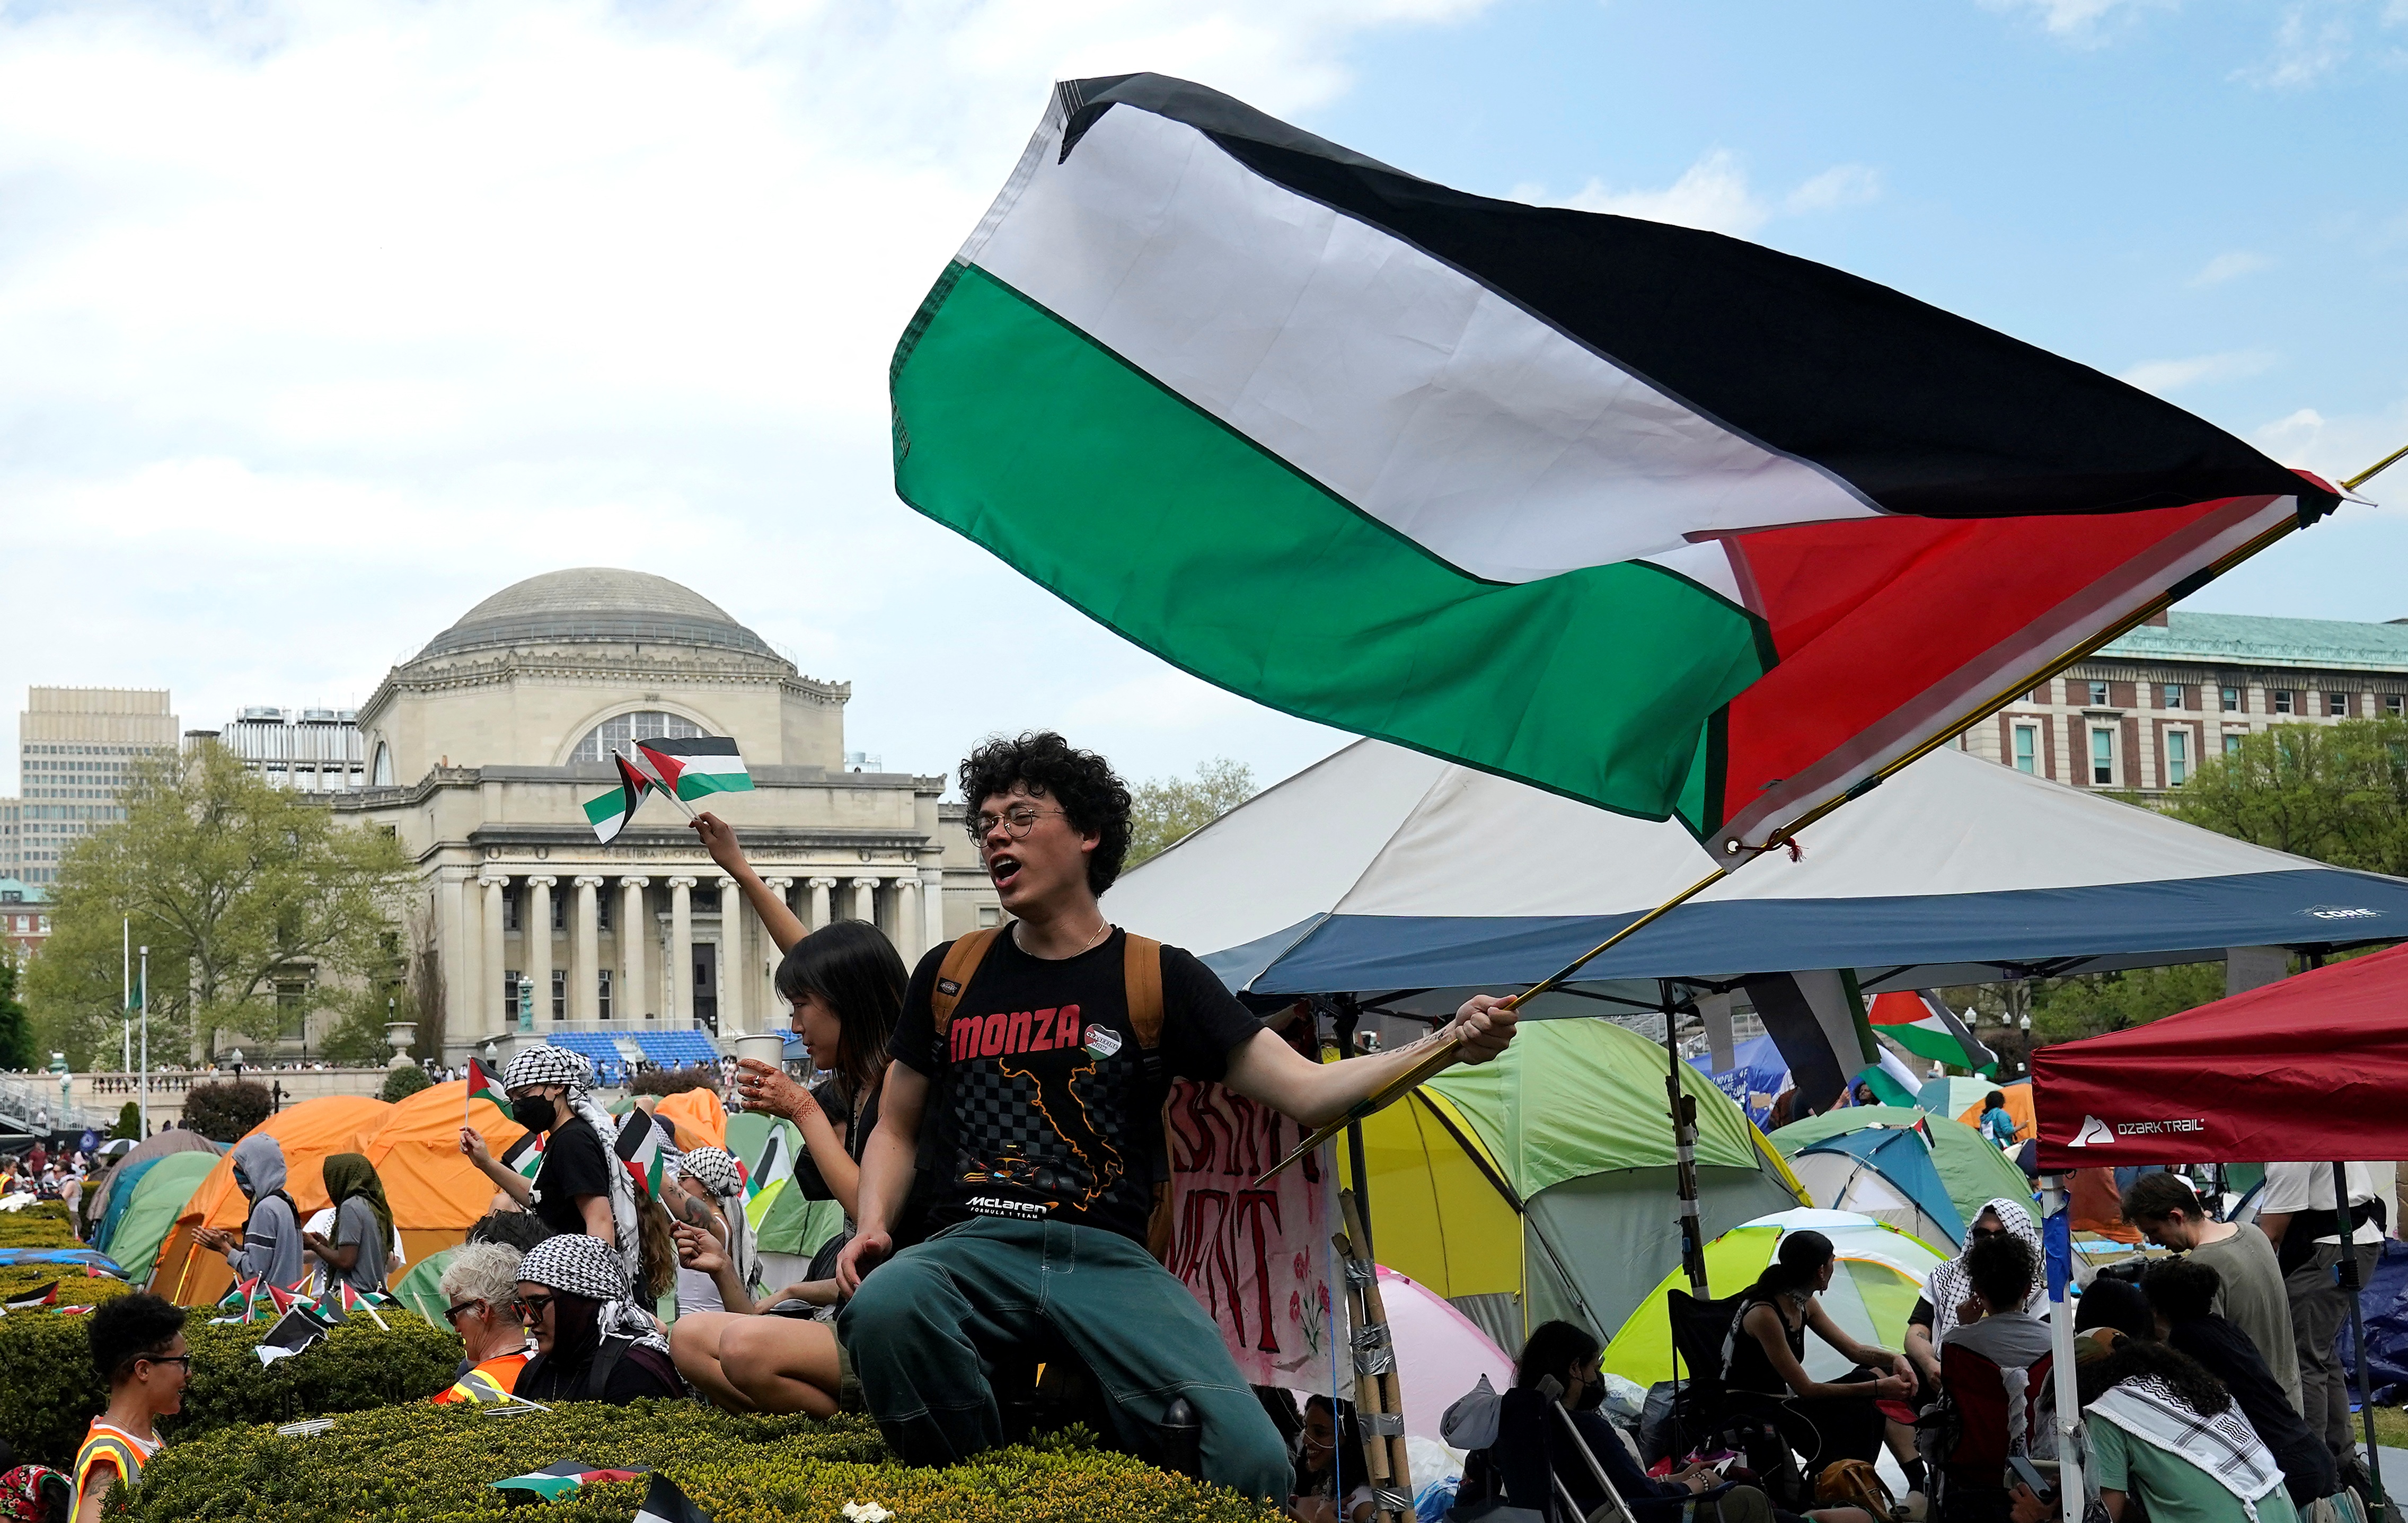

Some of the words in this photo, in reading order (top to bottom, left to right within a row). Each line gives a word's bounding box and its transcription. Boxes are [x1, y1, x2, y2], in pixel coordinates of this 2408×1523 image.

[627, 849, 670, 859] LIBRAY
[751, 851, 811, 860] UNIVERSITY
[2313, 909, 2376, 918] CORE
[950, 1004, 1080, 1063] MONZA
[1086, 1031, 1119, 1051] CEASEFIRE
[1091, 1041, 1108, 1051] NOW
[965, 1196, 1047, 1214] McLaren
[971, 1207, 1004, 1216] FORMULA
